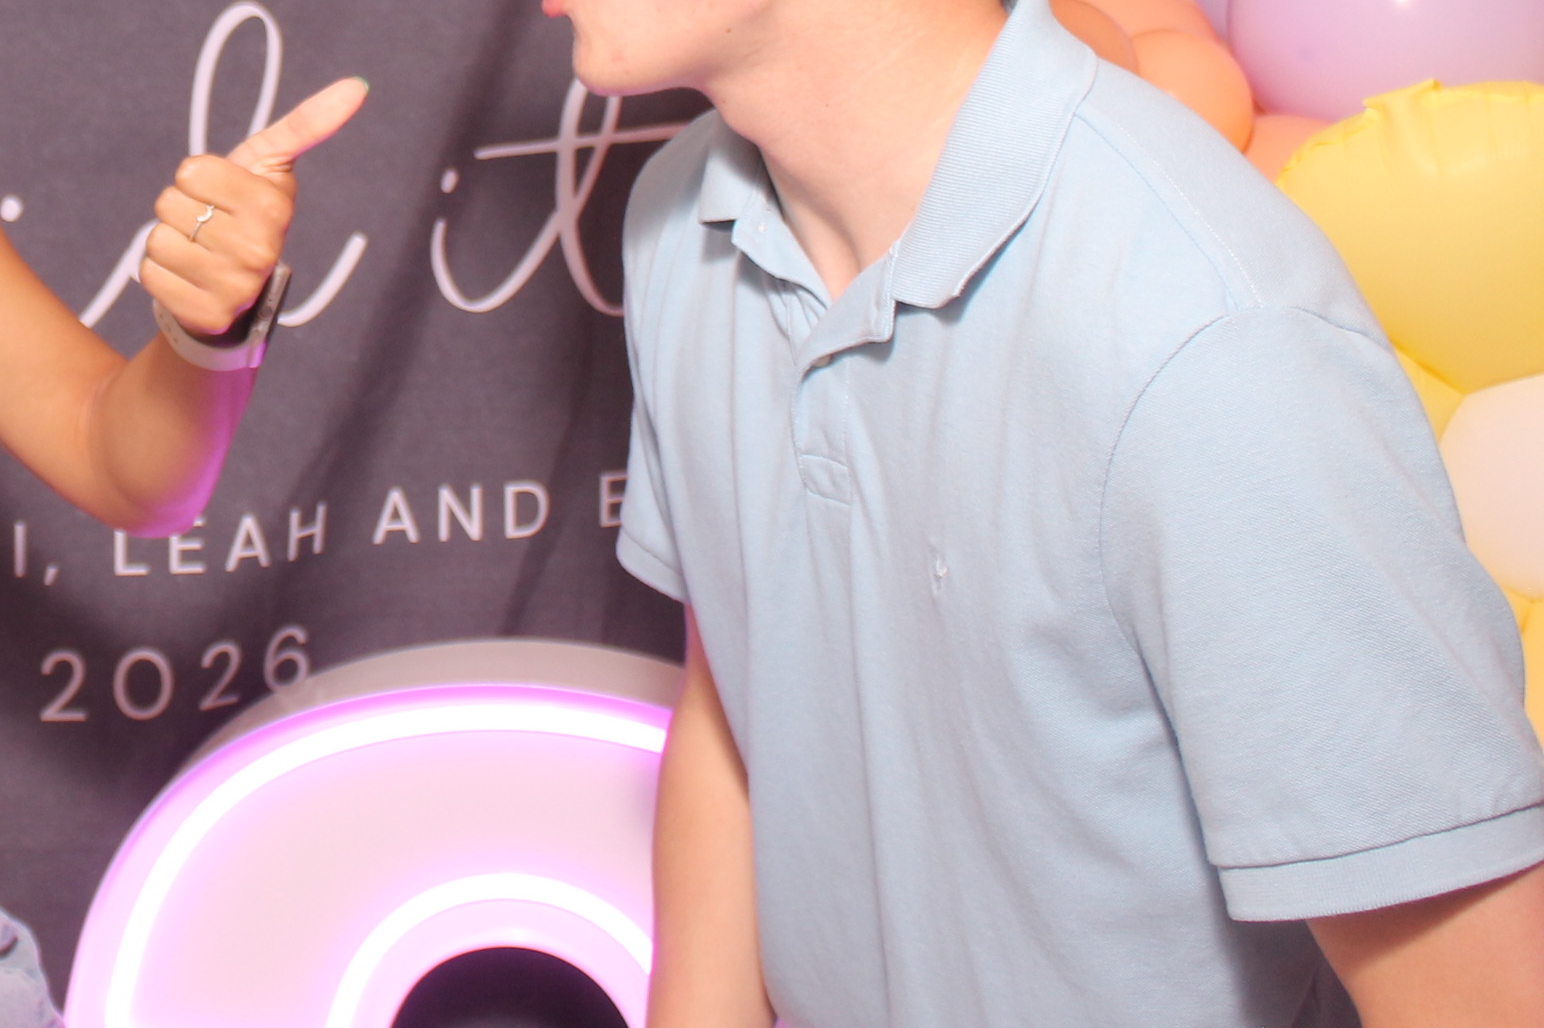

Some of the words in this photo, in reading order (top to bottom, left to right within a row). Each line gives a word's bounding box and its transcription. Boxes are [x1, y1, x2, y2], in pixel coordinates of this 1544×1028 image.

[113, 502, 327, 576] LEAH
[372, 479, 550, 546] AND
[39, 624, 308, 723] 2026
